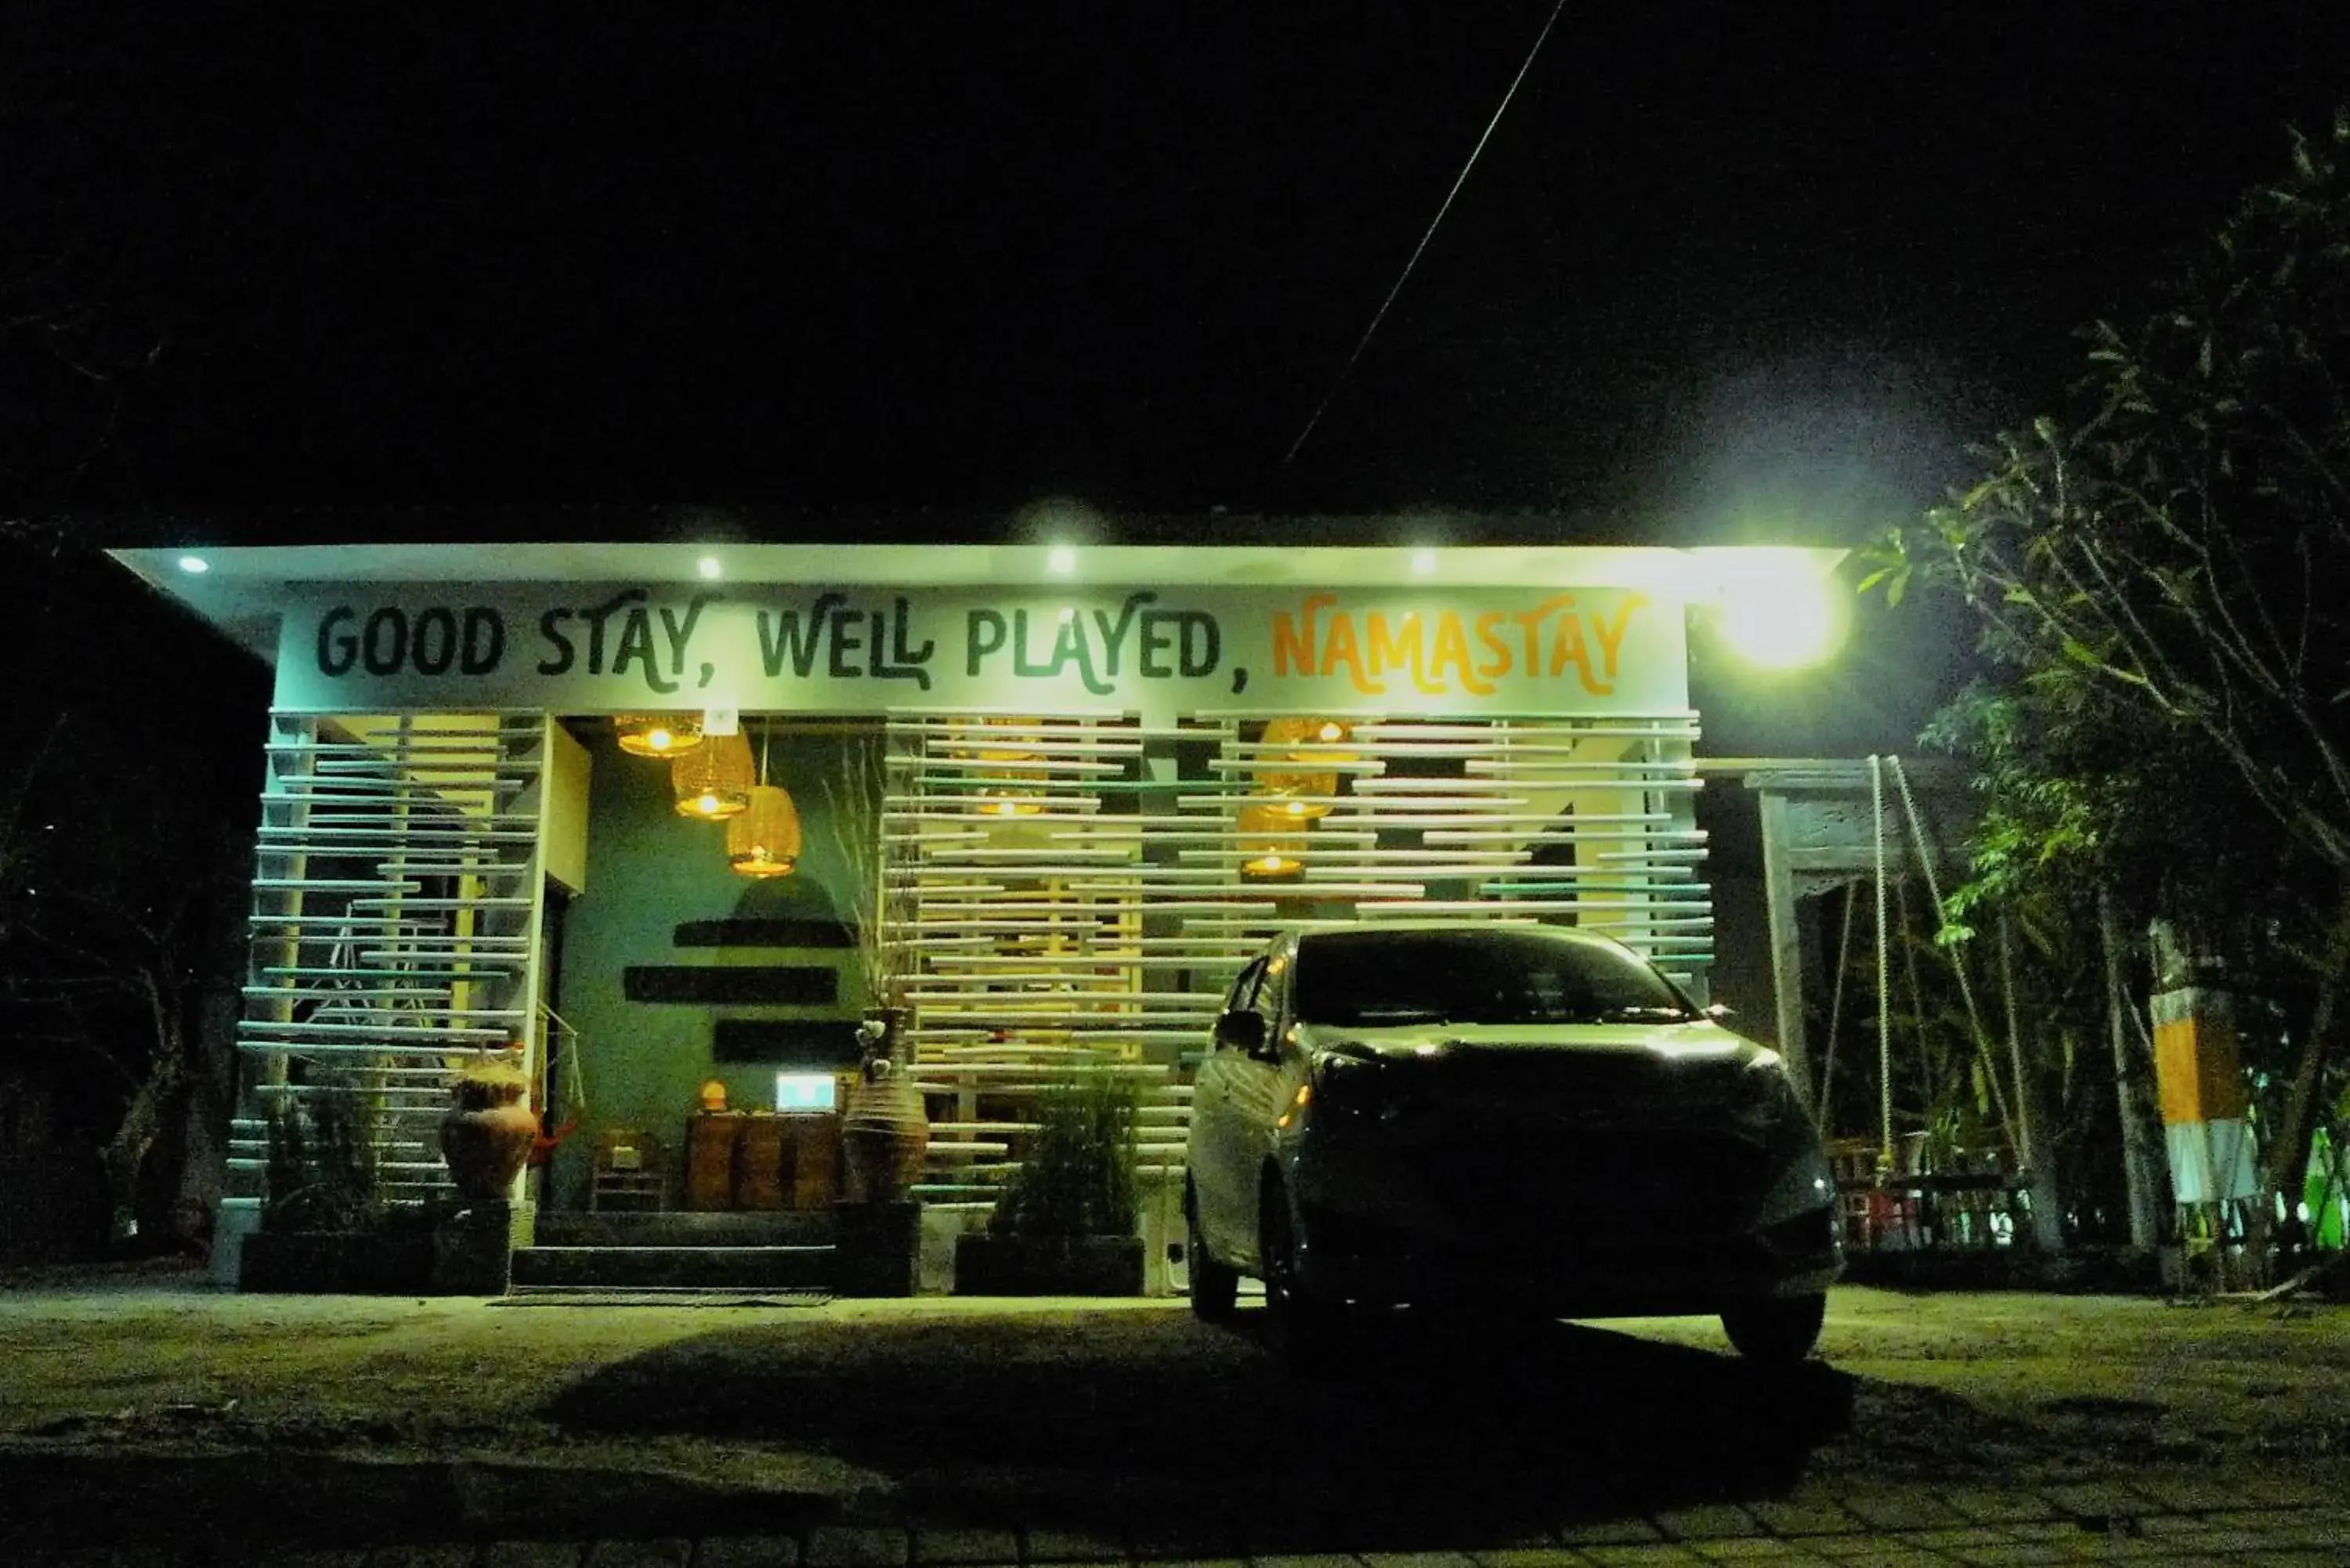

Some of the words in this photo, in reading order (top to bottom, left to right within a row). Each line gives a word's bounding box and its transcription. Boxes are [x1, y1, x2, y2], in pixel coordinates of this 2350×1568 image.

[316, 605, 506, 677] GOOD
[537, 587, 725, 695] STAY,
[757, 592, 935, 692] WELL
[966, 591, 1249, 695] PLAYED,
[1272, 594, 1649, 695] NAMASTAY
